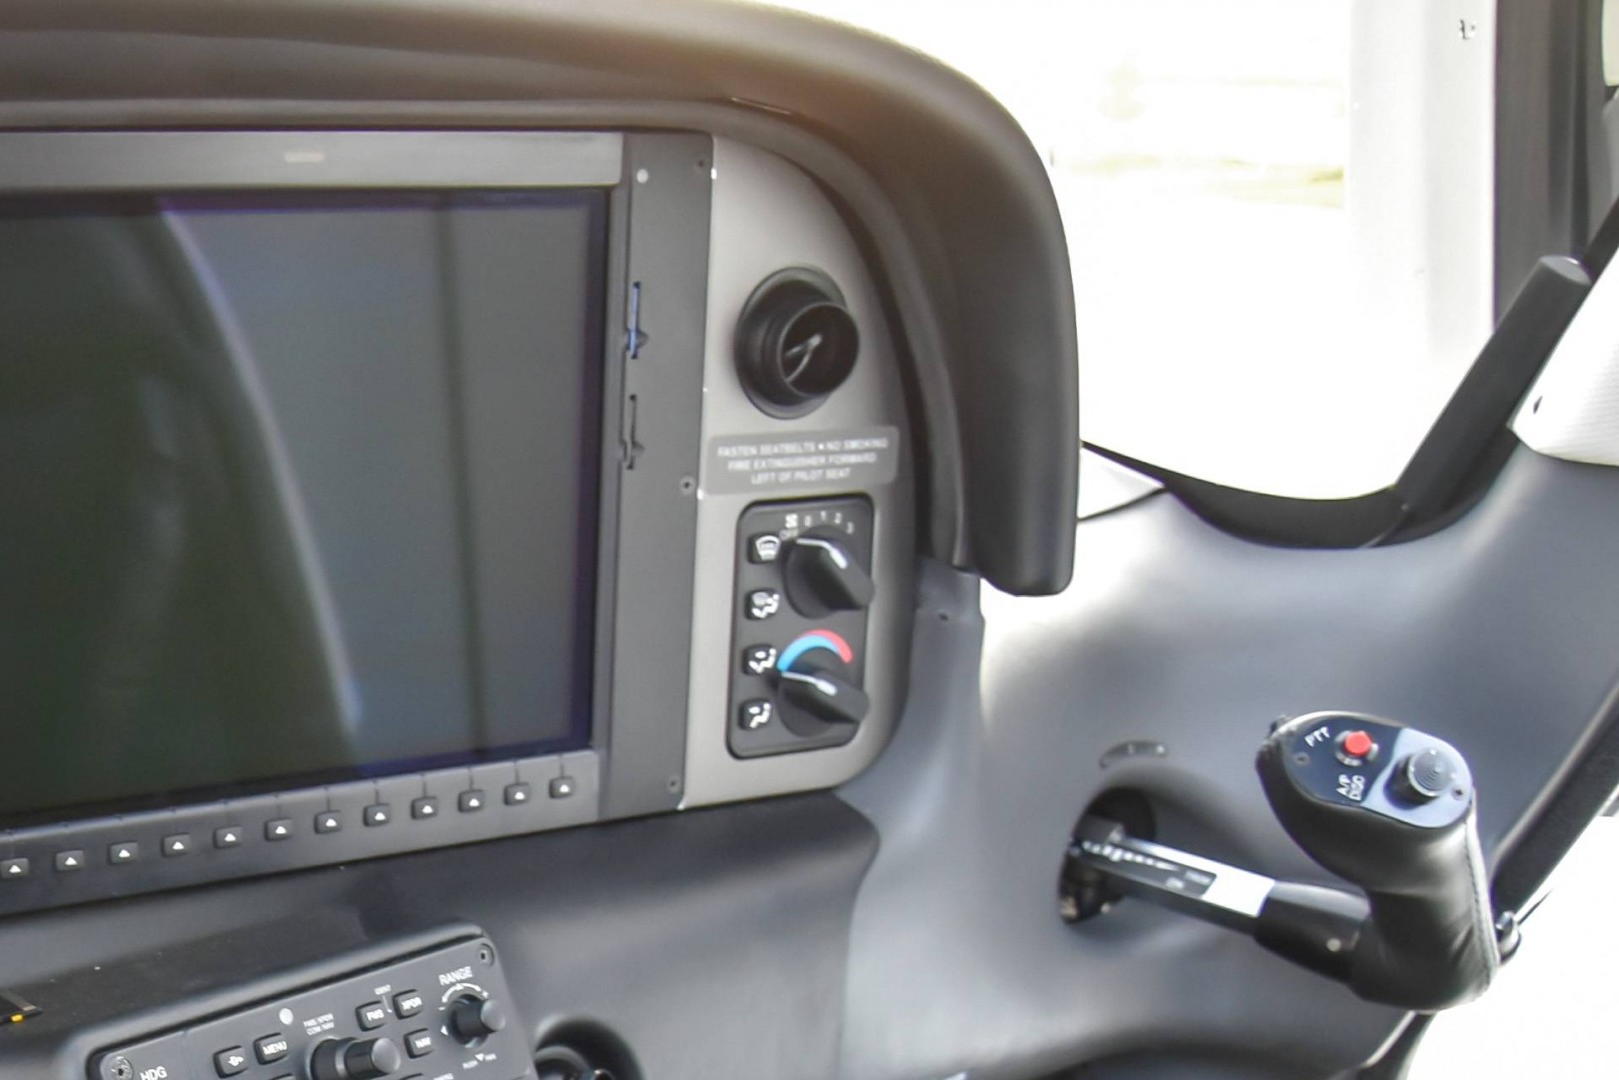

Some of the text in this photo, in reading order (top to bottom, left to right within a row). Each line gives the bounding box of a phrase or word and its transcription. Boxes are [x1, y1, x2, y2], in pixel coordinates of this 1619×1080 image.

[760, 442, 816, 454] SEATBELTS
[1304, 726, 1330, 748] PTT
[438, 966, 474, 986] RANGE
[366, 1008, 384, 1022] FMS
[262, 1040, 288, 1055] MENU
